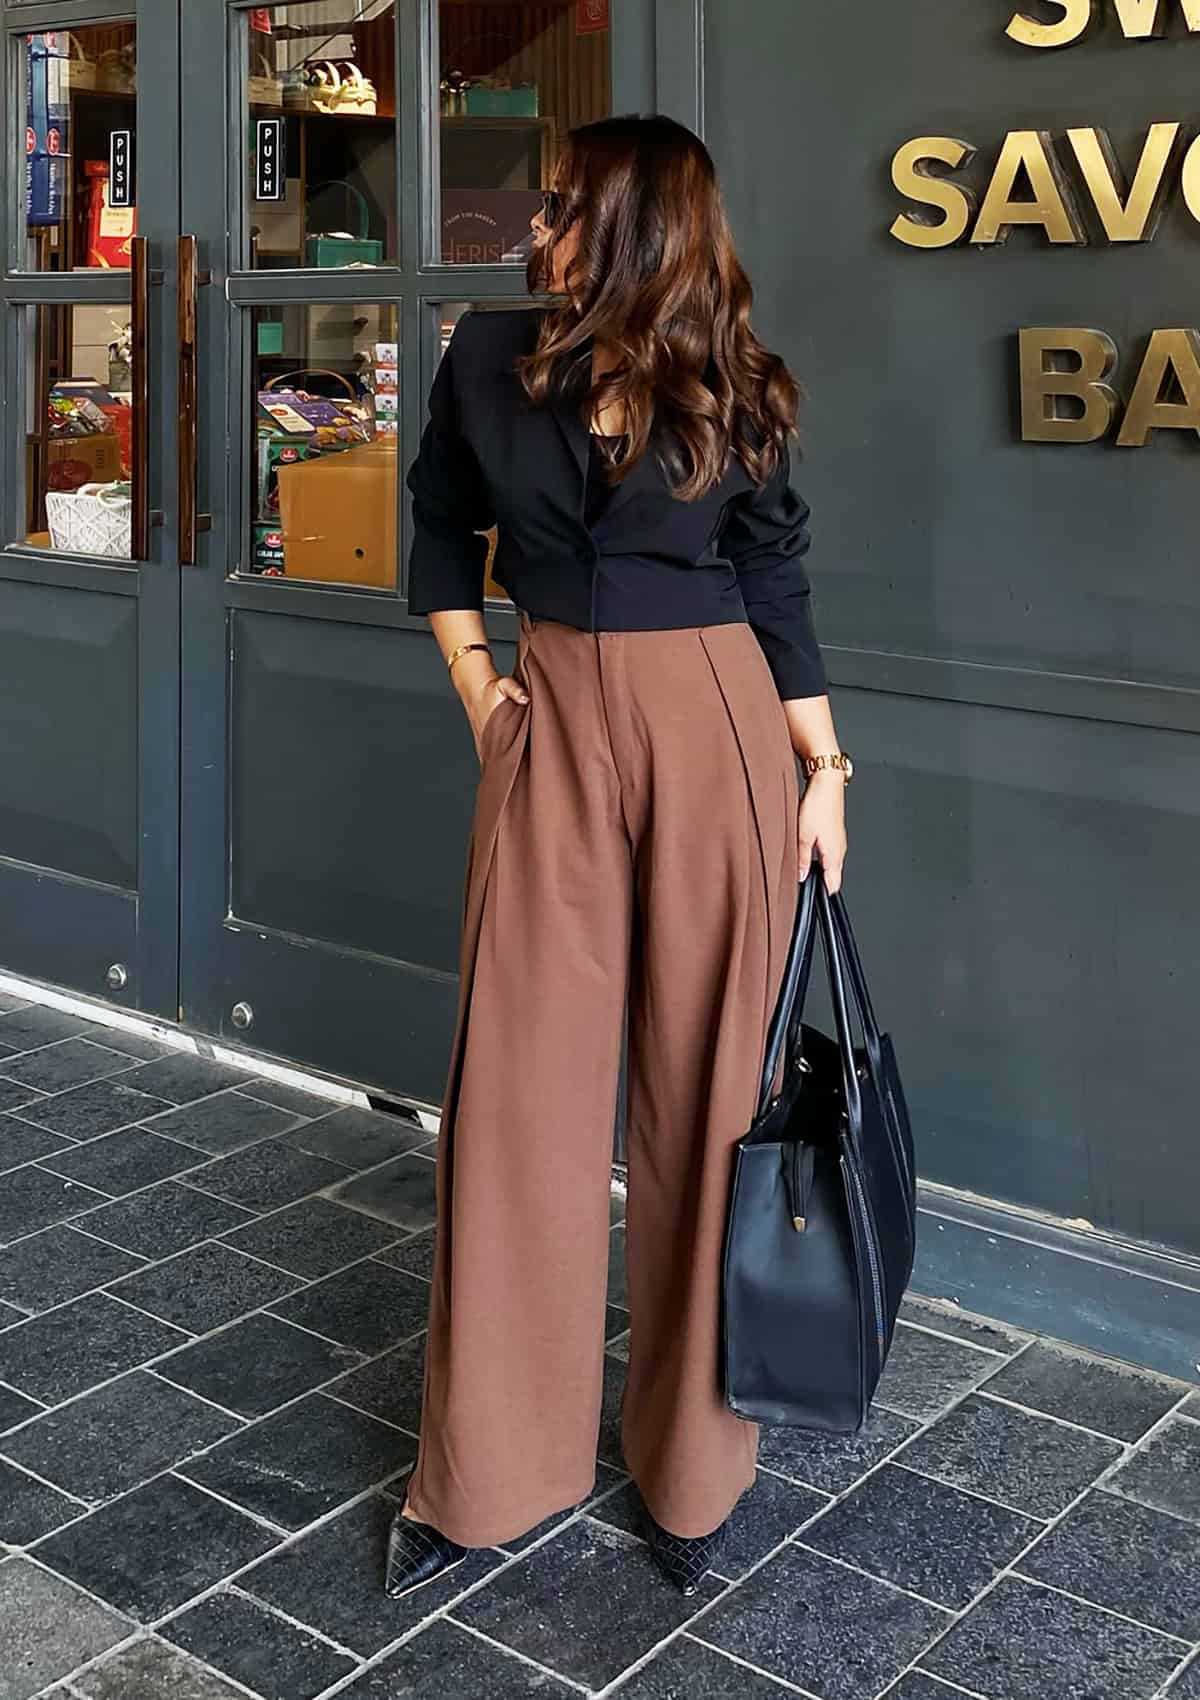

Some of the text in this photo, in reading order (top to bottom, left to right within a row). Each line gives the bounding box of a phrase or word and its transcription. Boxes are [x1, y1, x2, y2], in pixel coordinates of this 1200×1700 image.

[116, 138, 125, 198] PUSH
[264, 127, 273, 192] PUSH
[890, 122, 1200, 248] SAV
